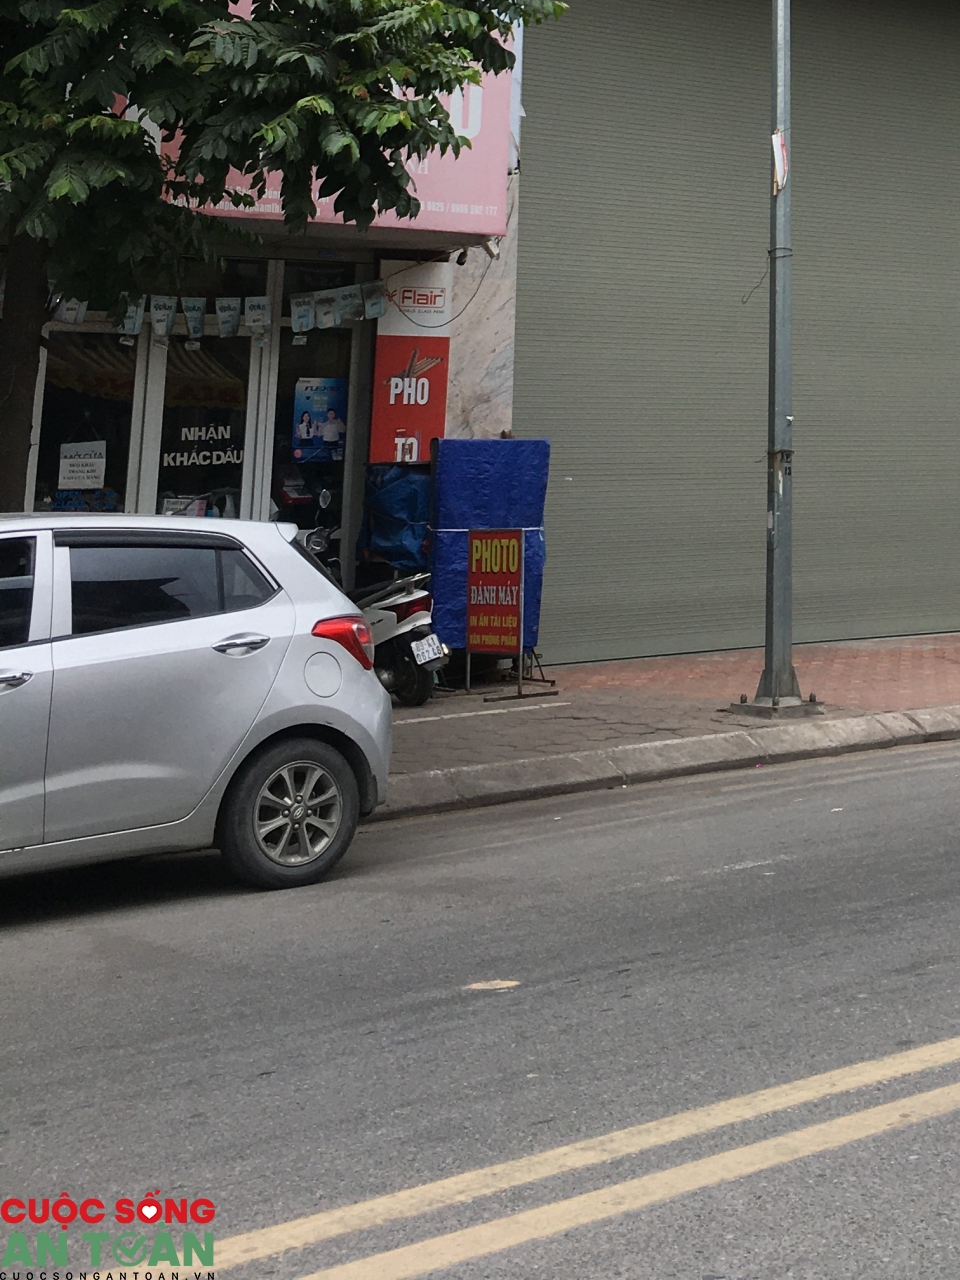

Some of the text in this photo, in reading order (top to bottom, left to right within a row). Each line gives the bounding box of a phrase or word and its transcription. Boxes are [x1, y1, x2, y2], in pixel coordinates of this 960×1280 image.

[401, 289, 444, 306] Flair
[389, 377, 429, 405] PHO
[181, 423, 231, 444] NHẬN
[163, 444, 244, 467] KHẮC DẤU
[472, 538, 519, 573] PHOTO
[471, 581, 519, 605] ĐÁNH MÁY
[470, 613, 517, 630] IN ẤN TÀI LIỆU
